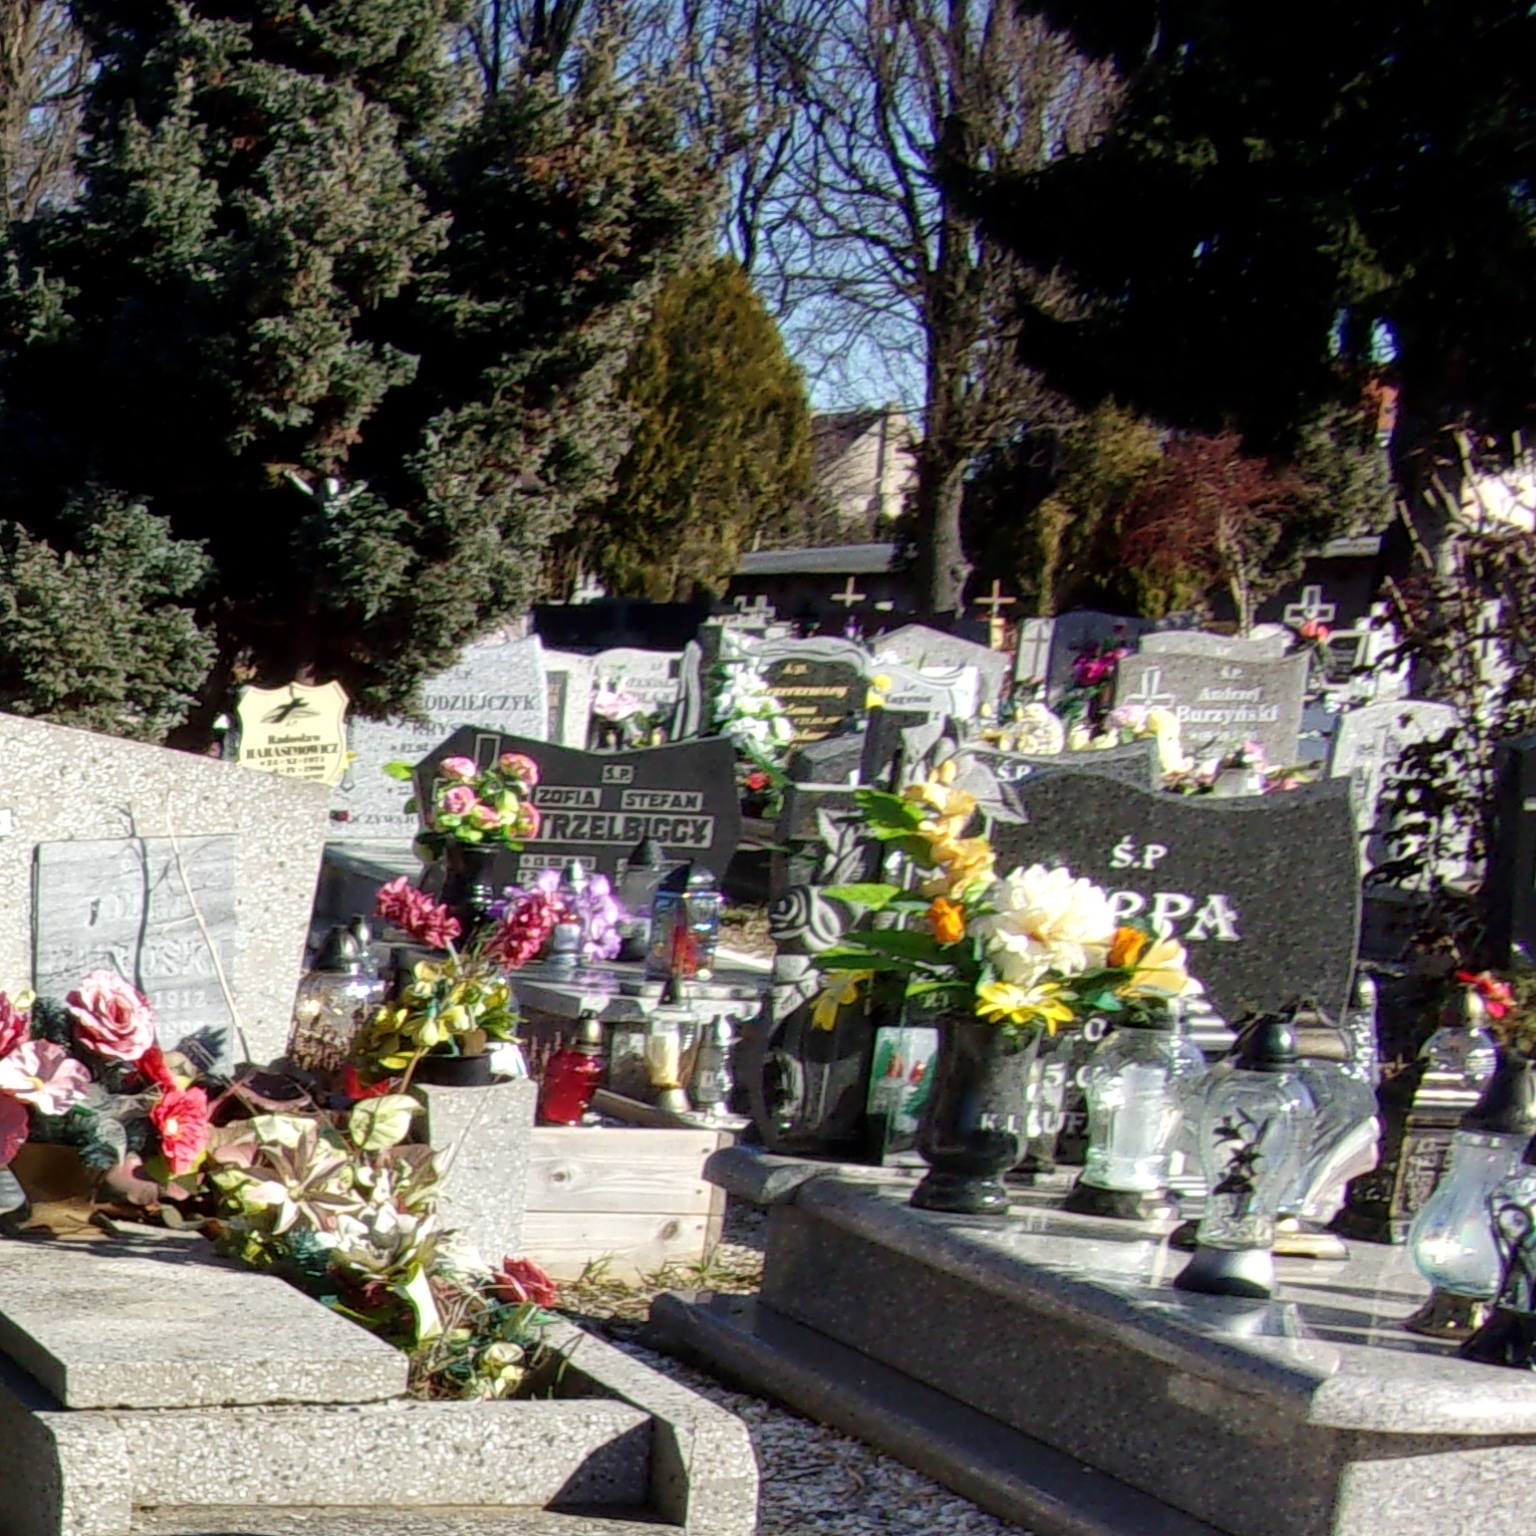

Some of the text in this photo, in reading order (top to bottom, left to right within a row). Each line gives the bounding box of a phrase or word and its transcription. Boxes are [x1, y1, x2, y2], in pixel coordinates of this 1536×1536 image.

[1199, 686, 1264, 702] Andrzej
[1175, 704, 1279, 725] Burzyński
[538, 789, 700, 810] ZOFIA STEFAN
